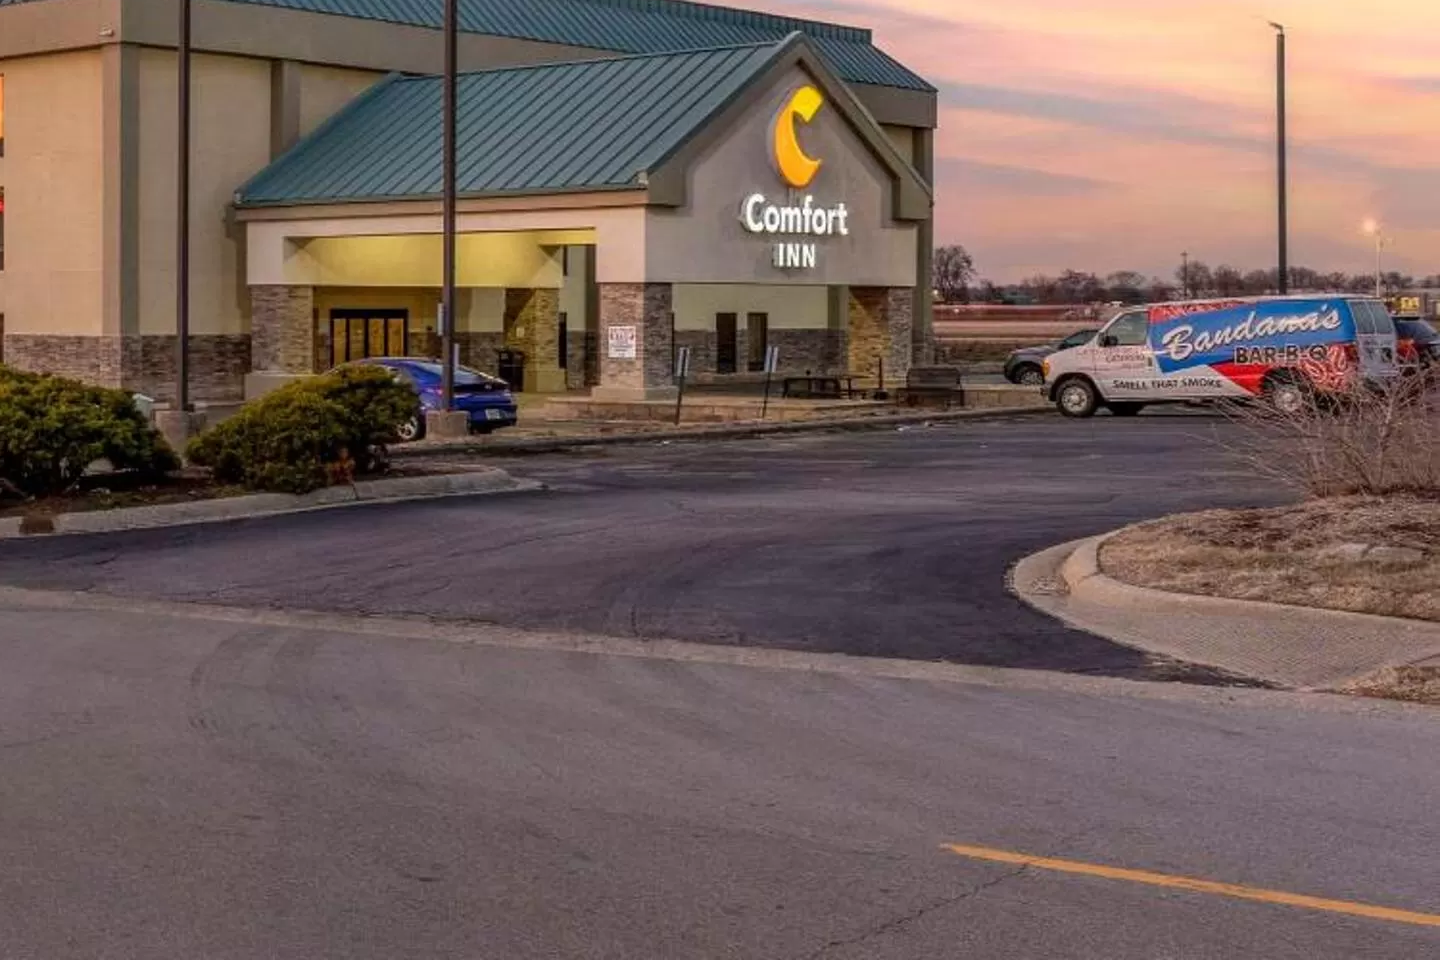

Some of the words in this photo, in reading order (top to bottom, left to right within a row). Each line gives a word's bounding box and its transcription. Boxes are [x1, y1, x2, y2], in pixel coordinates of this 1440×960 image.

[745, 193, 849, 235] Comfort
[777, 243, 816, 268] INN
[1162, 304, 1341, 360] Bandana's
[1234, 343, 1328, 365] BAR-B-Q
[1112, 379, 1148, 390] SMELL
[1151, 379, 1178, 389] THAT
[1182, 377, 1224, 388] SMOKE
